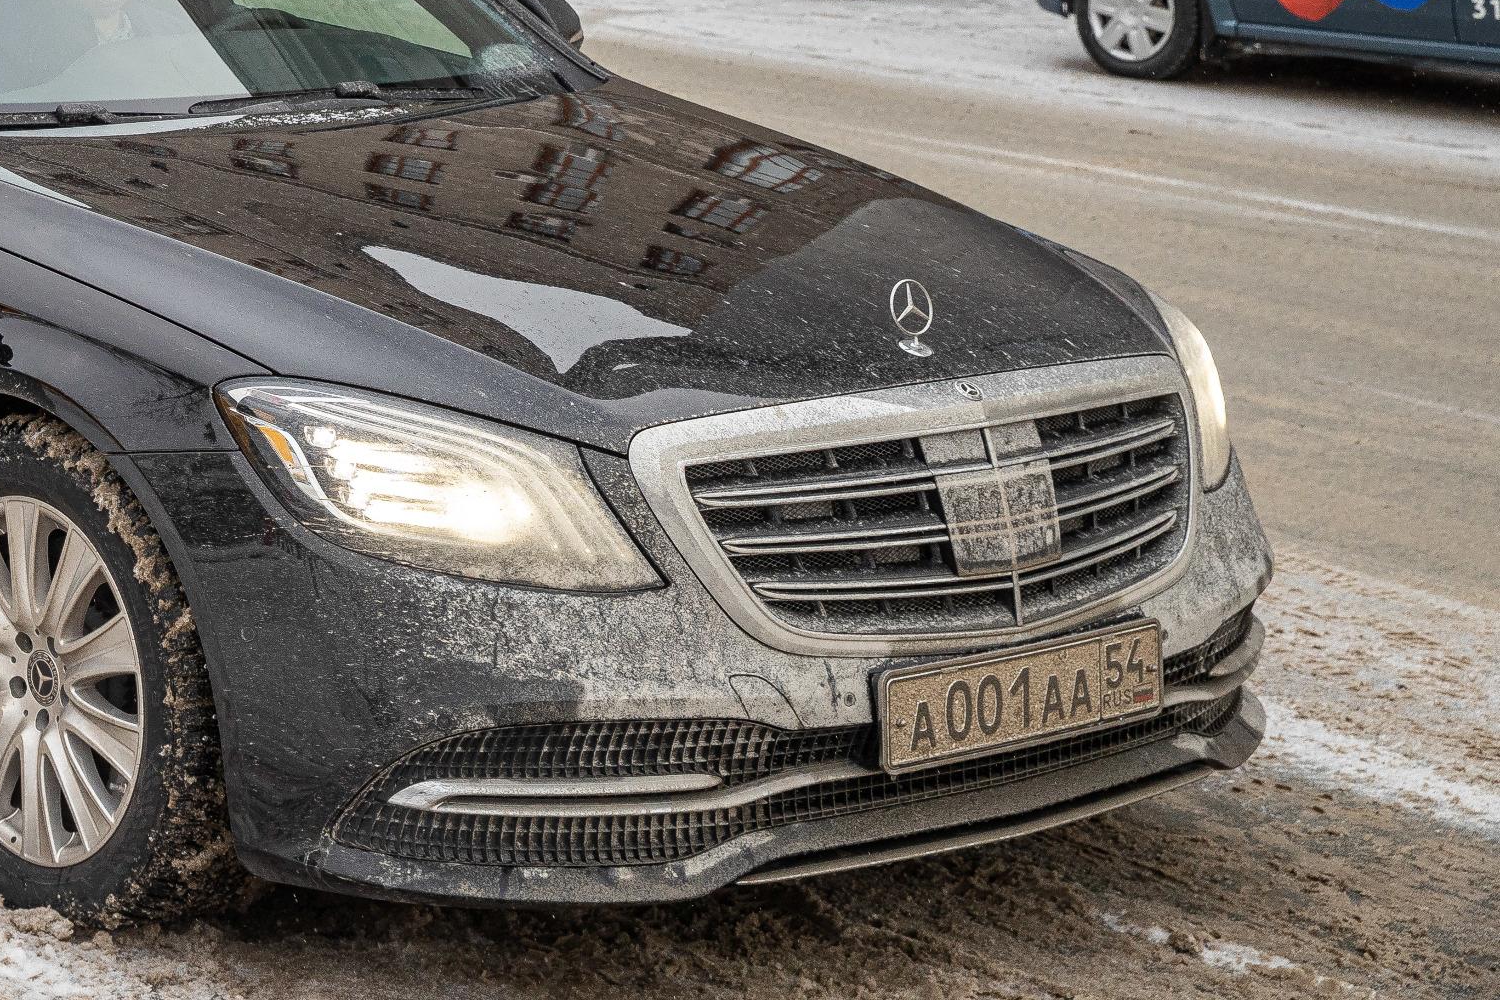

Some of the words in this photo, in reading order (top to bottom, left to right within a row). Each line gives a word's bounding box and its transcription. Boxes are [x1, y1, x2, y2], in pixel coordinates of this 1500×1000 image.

[910, 667, 1093, 751] А001АА
[1104, 638, 1144, 690] 54
[1103, 688, 1132, 709] RUS
